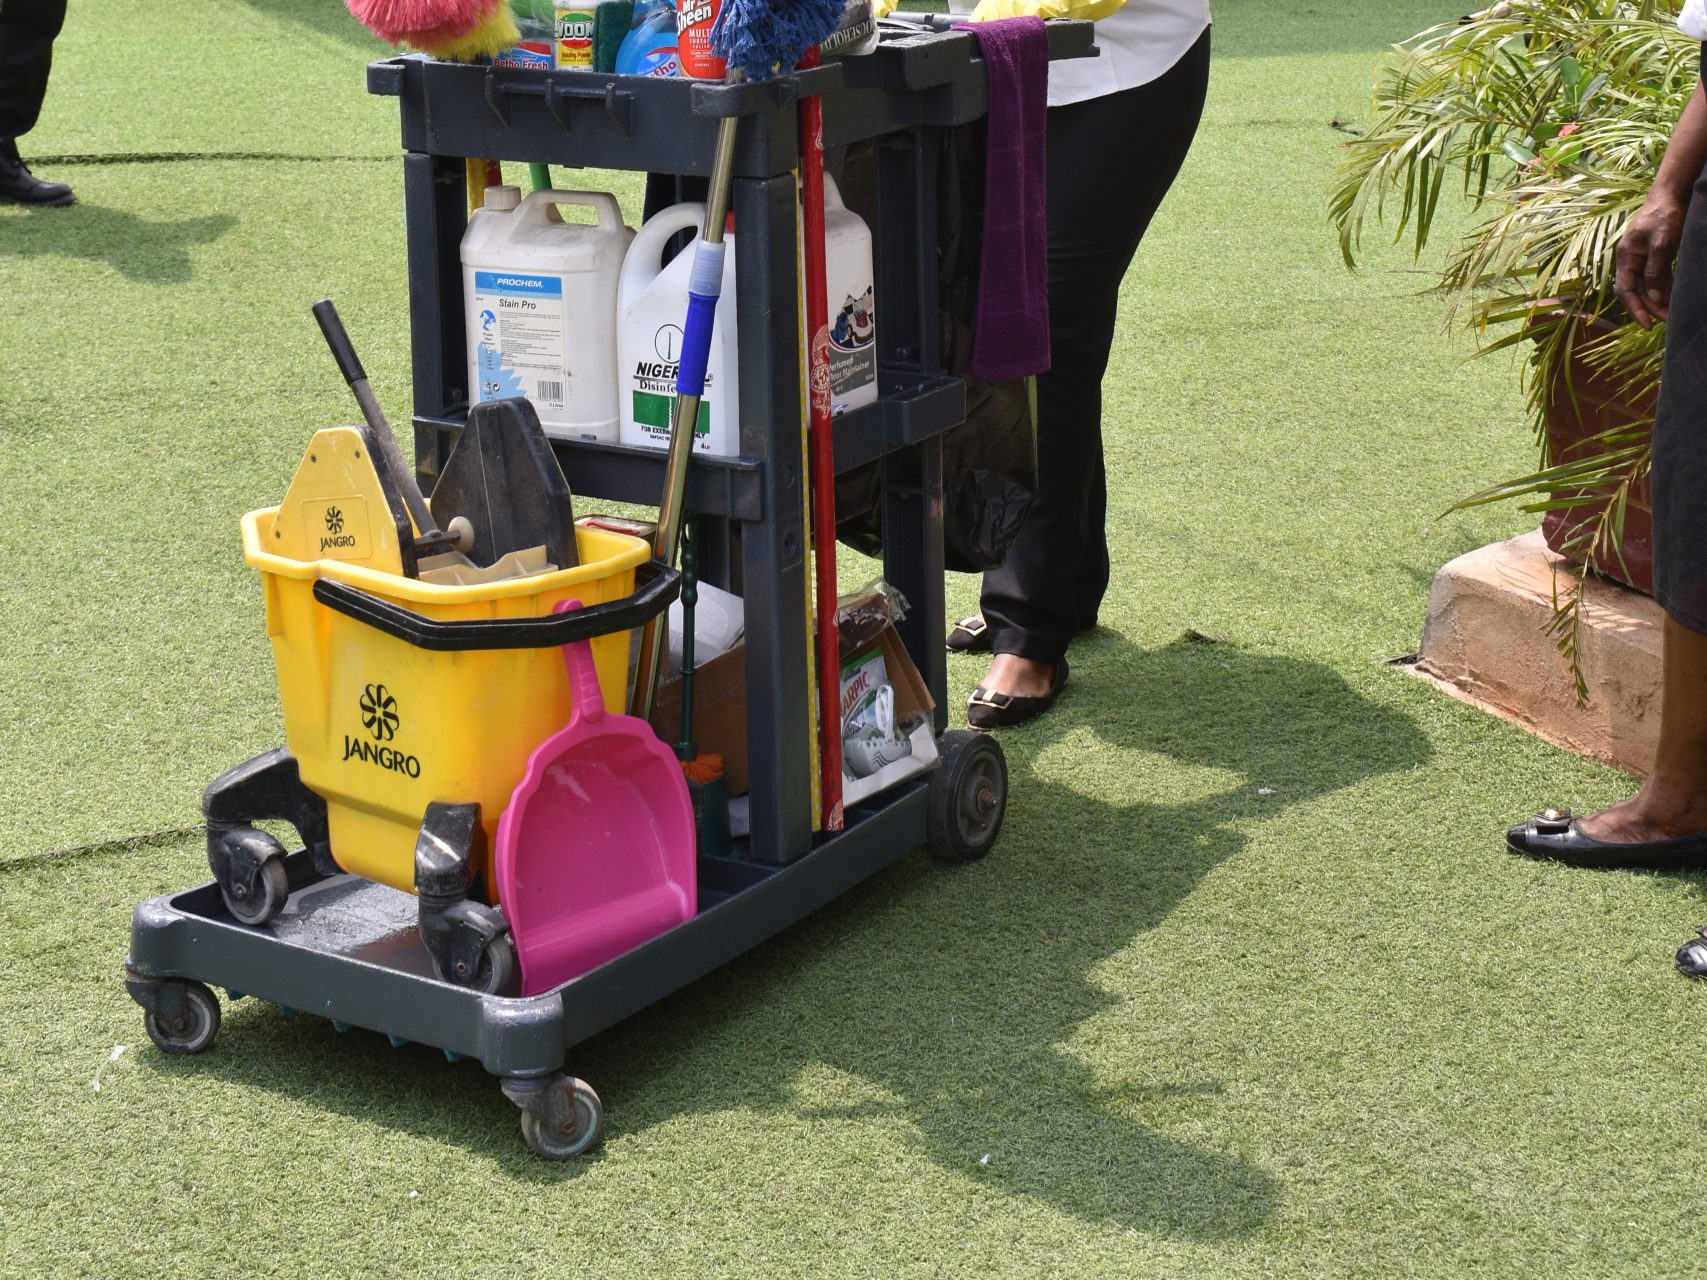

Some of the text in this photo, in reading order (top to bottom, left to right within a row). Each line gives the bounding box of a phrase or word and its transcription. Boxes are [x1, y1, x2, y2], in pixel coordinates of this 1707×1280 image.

[682, 0, 696, 13] Mr
[677, 5, 712, 36] Sheen
[689, 28, 710, 38] MULT
[824, 20, 873, 50] OUSEHOLD
[495, 58, 520, 68] Betho
[522, 60, 548, 70] Fresh
[499, 298, 537, 310] Stain Pro
[640, 380, 677, 393] Disinfe
[320, 535, 356, 552] JANGRO
[840, 671, 870, 717] ARPIC
[342, 734, 421, 779] JANGRO
